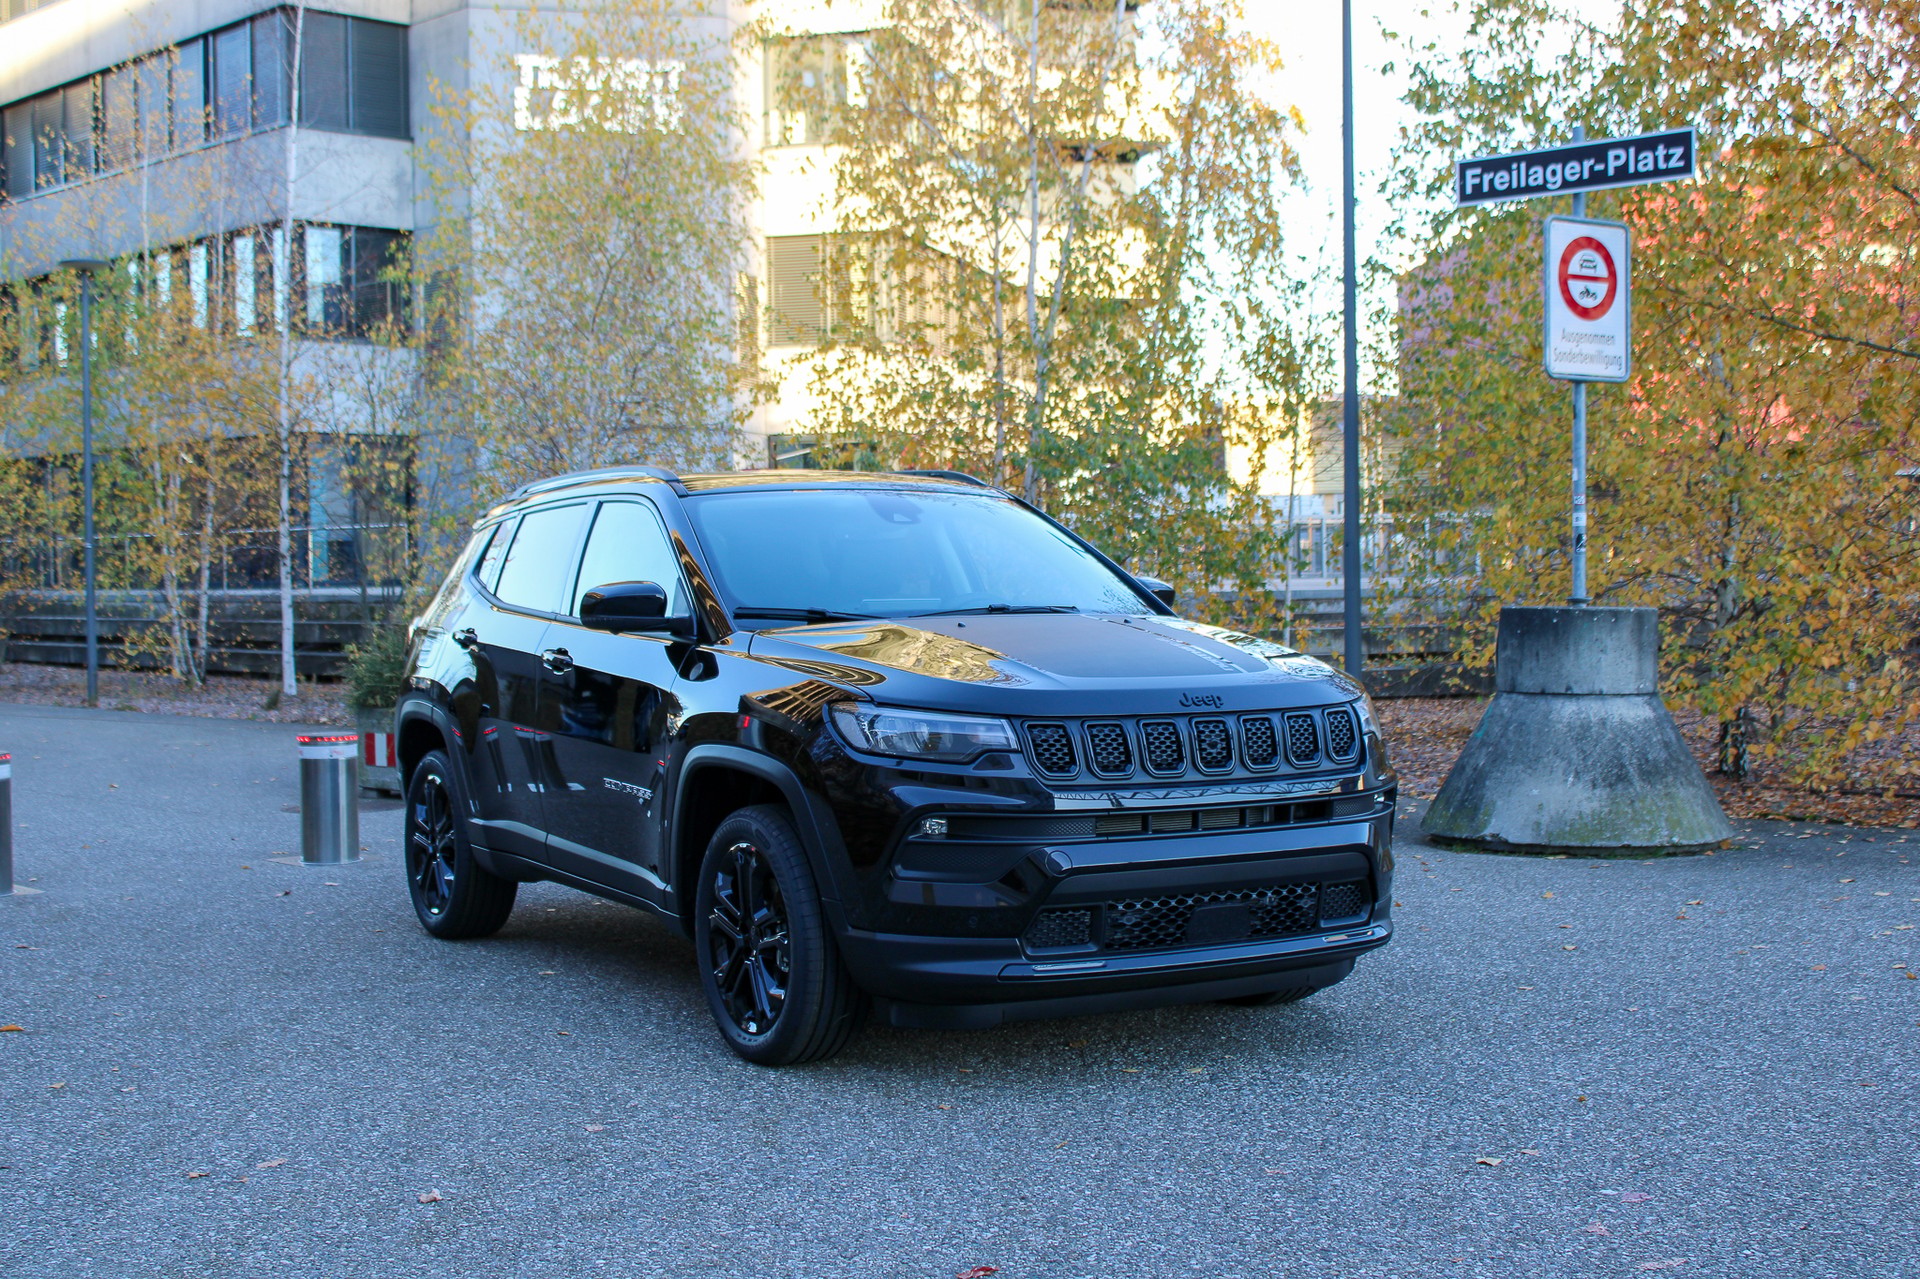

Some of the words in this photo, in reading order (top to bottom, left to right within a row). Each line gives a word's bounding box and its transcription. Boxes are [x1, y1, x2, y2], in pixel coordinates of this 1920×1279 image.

[1465, 145, 1685, 195] Freilager-Platz
[1561, 328, 1615, 347] Ausgenommen
[1179, 692, 1224, 708] Jeep
